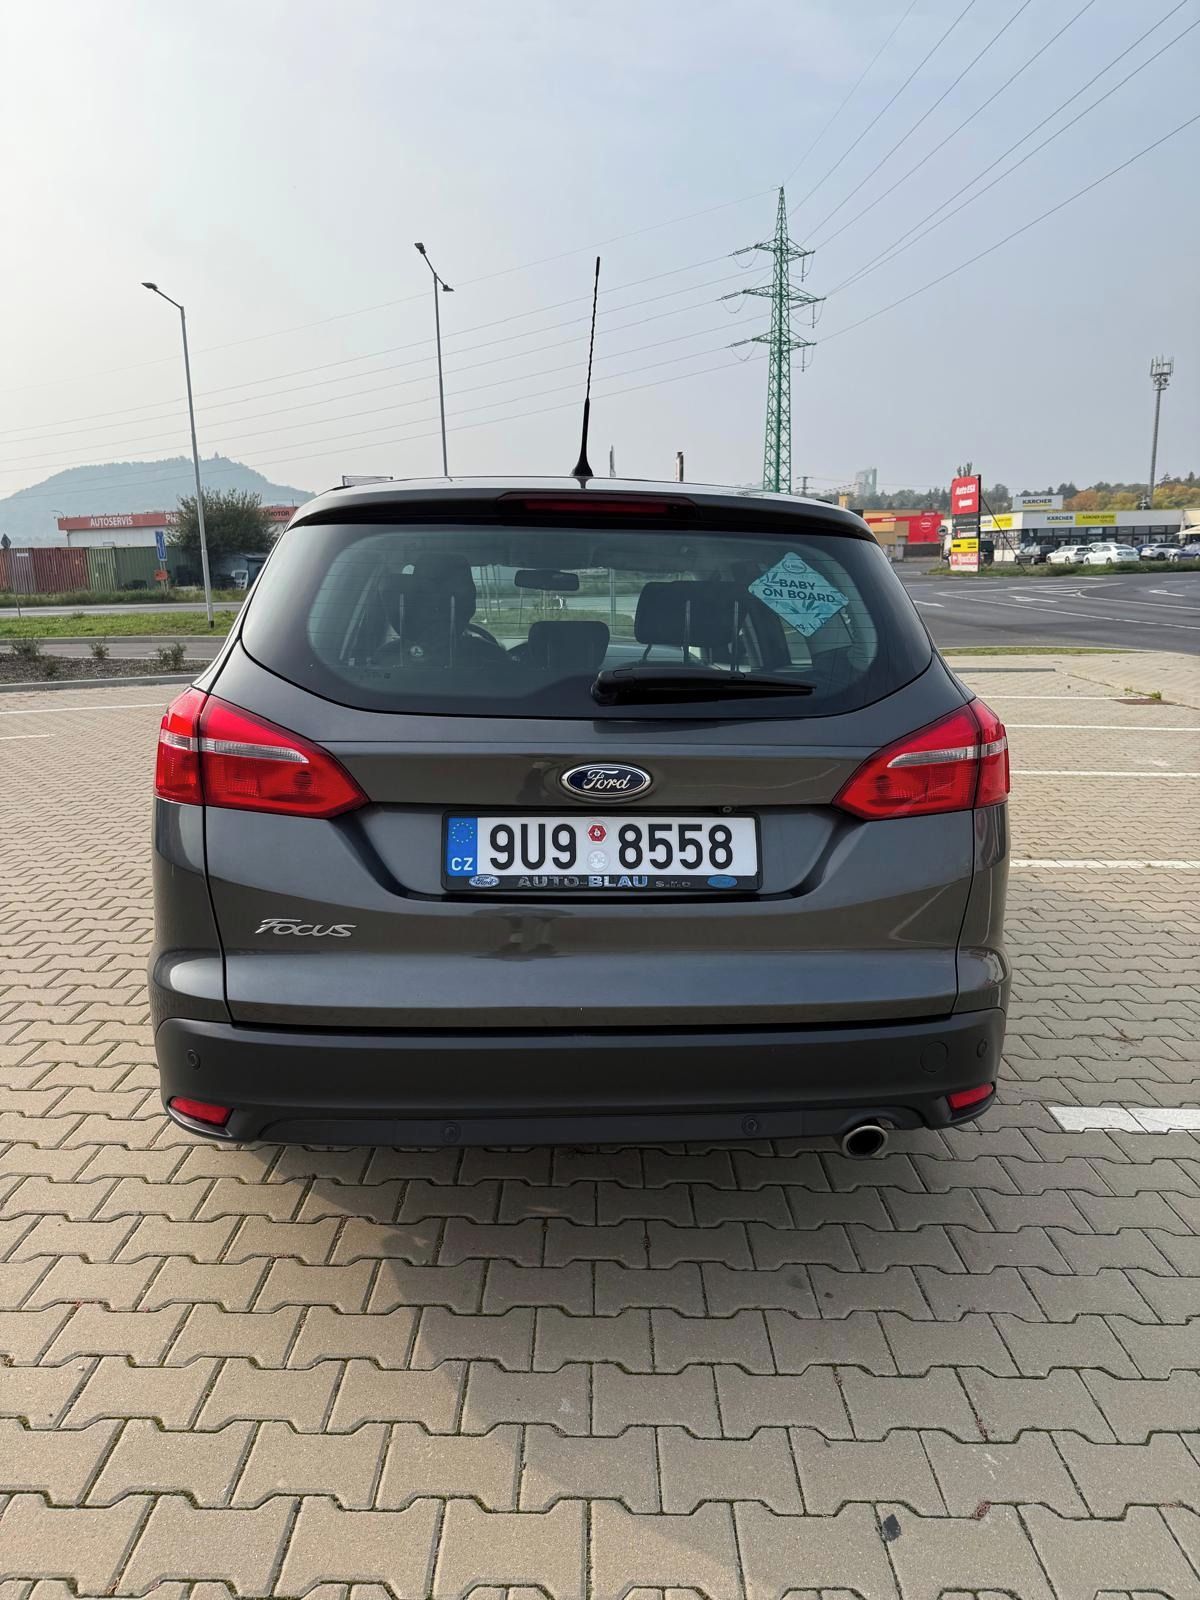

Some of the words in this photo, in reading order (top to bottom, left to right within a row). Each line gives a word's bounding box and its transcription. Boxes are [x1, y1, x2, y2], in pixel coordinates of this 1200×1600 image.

[90, 516, 133, 527] AUTOSERVIS
[779, 579, 815, 590] BABY
[762, 588, 784, 598] ON
[788, 590, 836, 603] BOARD
[583, 769, 631, 790] Ford
[489, 823, 577, 870] 9U9
[618, 823, 733, 870] 8558
[451, 857, 473, 871] CZ
